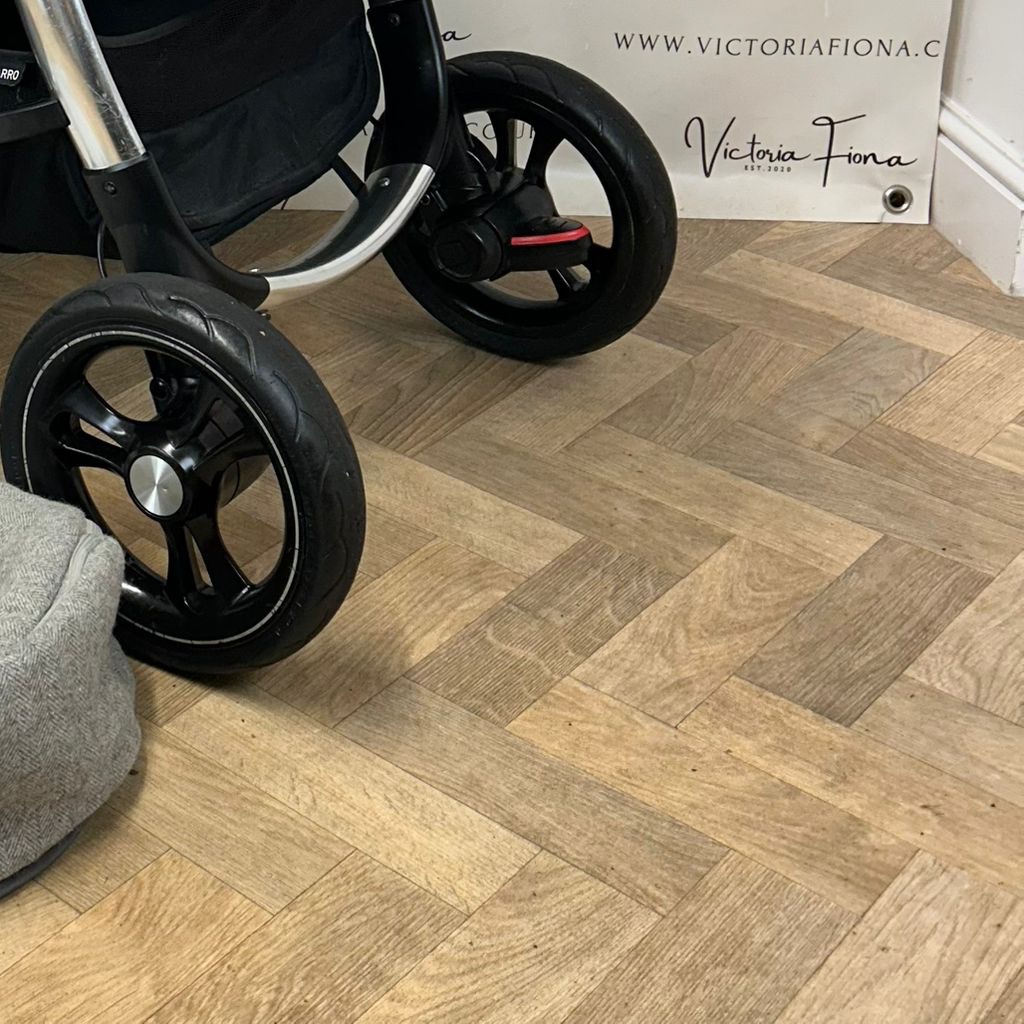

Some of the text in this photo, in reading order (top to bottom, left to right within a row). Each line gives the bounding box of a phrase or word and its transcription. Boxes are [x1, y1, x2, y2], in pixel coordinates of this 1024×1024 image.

[614, 32, 941, 57] WWW.VICTORIAFIONA.C
[684, 114, 918, 188] Victoria Fiona
[743, 164, 792, 172] EST.2020
